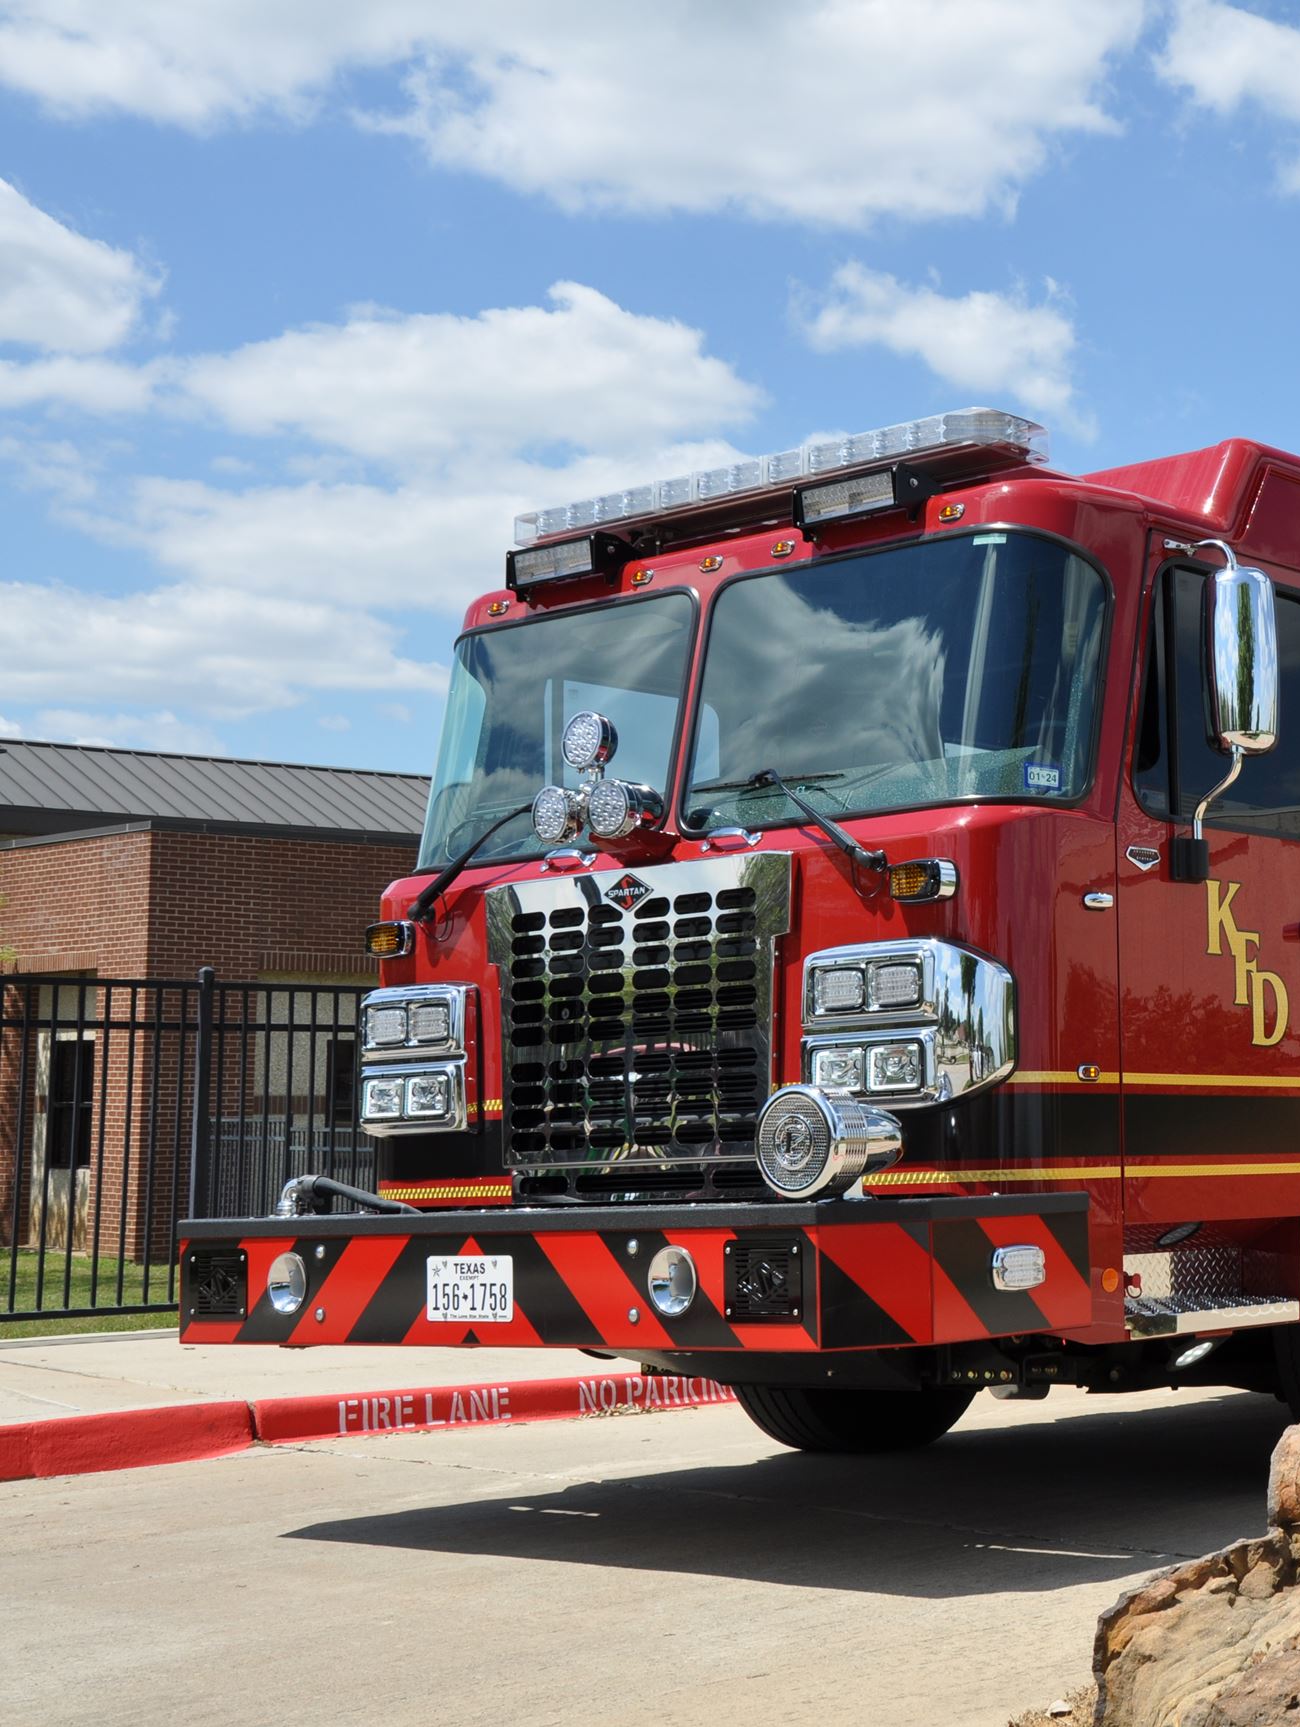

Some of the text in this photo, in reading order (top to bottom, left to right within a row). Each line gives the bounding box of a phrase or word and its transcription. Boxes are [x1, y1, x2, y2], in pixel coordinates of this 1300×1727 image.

[1029, 771, 1057, 783] 01 24
[607, 886, 646, 898] SPARTAN
[1205, 879, 1289, 1047] KFD
[453, 1262, 486, 1275] TEXAS
[578, 1379, 617, 1412] NO
[338, 1387, 512, 1434] FIRE LANE
